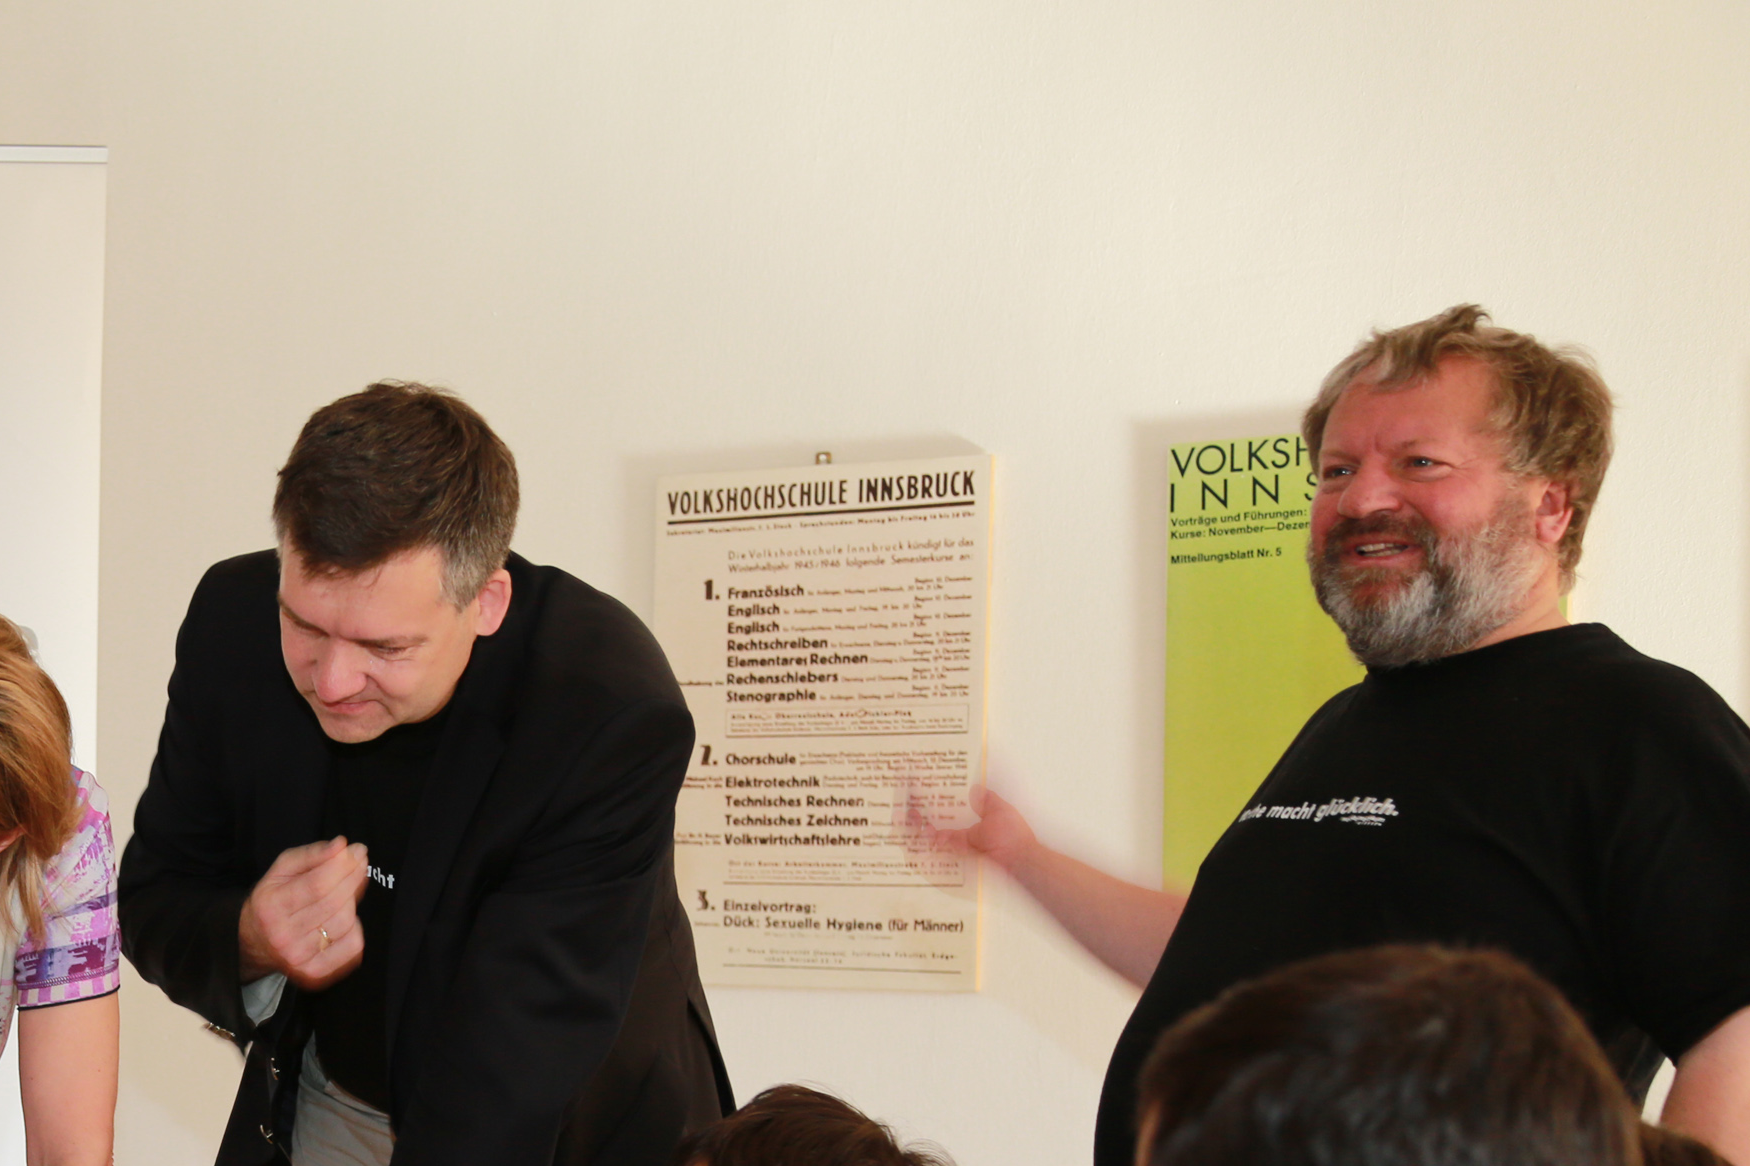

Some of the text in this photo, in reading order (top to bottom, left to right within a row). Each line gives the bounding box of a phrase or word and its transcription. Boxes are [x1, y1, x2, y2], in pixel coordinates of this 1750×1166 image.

[667, 470, 975, 516] VOLKSHOCHSCHULE INNSBRUCK
[1171, 508, 1307, 528] Vorträge und Führungen:
[1171, 529, 1206, 541] Kurse:
[728, 549, 746, 561] Die
[748, 544, 843, 561] Volkshochschule
[847, 540, 903, 555] Innsbruck
[907, 538, 942, 552] kündigt
[958, 536, 974, 548] das
[1171, 547, 1282, 564] Mitteilungsblatt Nr. 5
[846, 556, 885, 569] folgende
[891, 553, 953, 565] Semesterkurse
[704, 579, 720, 600] 1.
[728, 583, 804, 600] Französisch
[728, 603, 780, 619] Englisch
[727, 621, 780, 635] Englisch
[727, 636, 828, 652] Rechtschreiben
[810, 652, 868, 665] Rechnen
[727, 671, 838, 686] Rechenschiebers
[727, 689, 816, 704] Stenographie
[725, 752, 796, 766] Chorschule
[725, 775, 820, 789] Elektrotechnik
[725, 795, 801, 808] Technisches
[806, 795, 865, 808] Rechnen
[1266, 801, 1317, 820] macht
[1313, 796, 1399, 822] glücklich.
[725, 814, 801, 827] Technisches
[806, 814, 868, 827] Zeichnen
[724, 833, 861, 847] Volkswirtschaftslehre
[696, 889, 817, 914] 3. Einzelvortrag:
[723, 915, 761, 928] Dück:
[765, 916, 821, 930] Sexuelle
[827, 918, 883, 933] Hygiene
[888, 919, 909, 933] (für
[913, 920, 964, 934] Männer)
